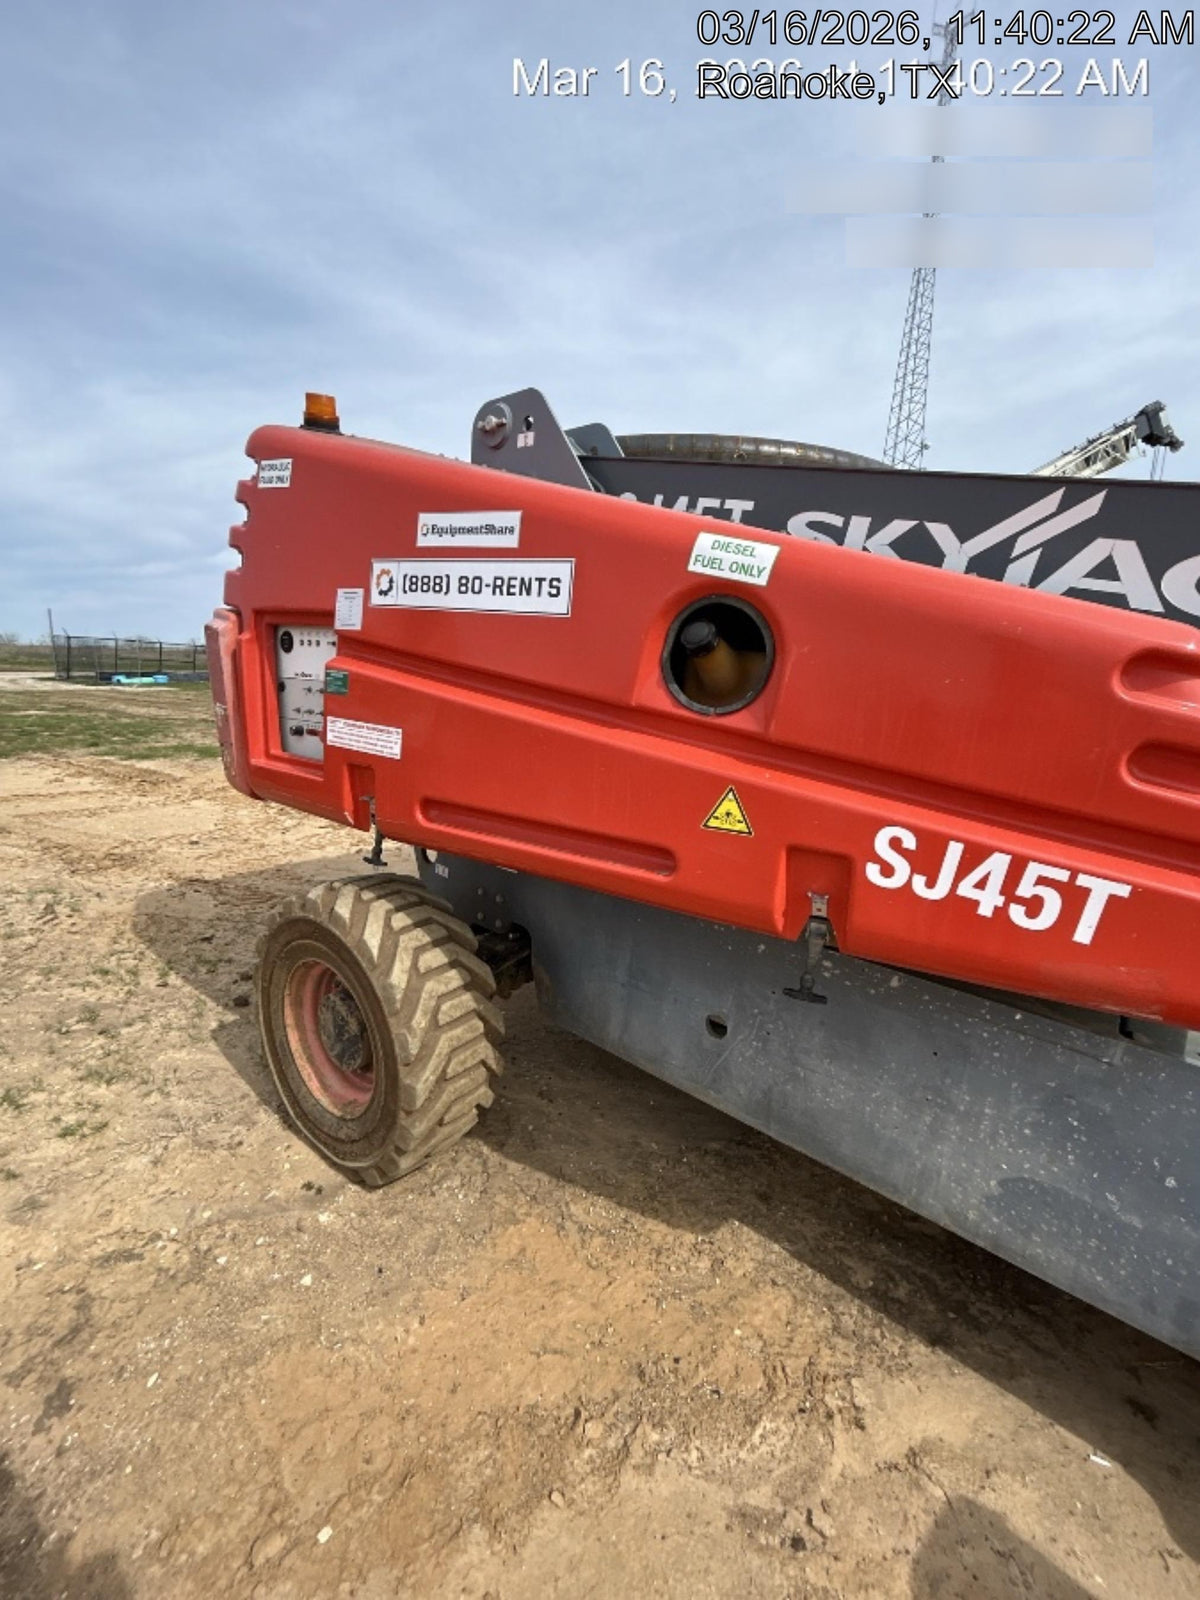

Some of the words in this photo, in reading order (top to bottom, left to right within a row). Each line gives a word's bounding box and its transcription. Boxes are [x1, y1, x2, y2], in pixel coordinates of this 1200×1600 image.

[431, 523, 515, 538] EquipmentShare
[711, 539, 757, 558] DIESEL
[692, 554, 726, 572] FUEL
[728, 560, 767, 579] ONLY
[402, 573, 450, 596] (888)
[457, 575, 562, 598] 80-RENTS
[864, 825, 1132, 946] SJ45T
